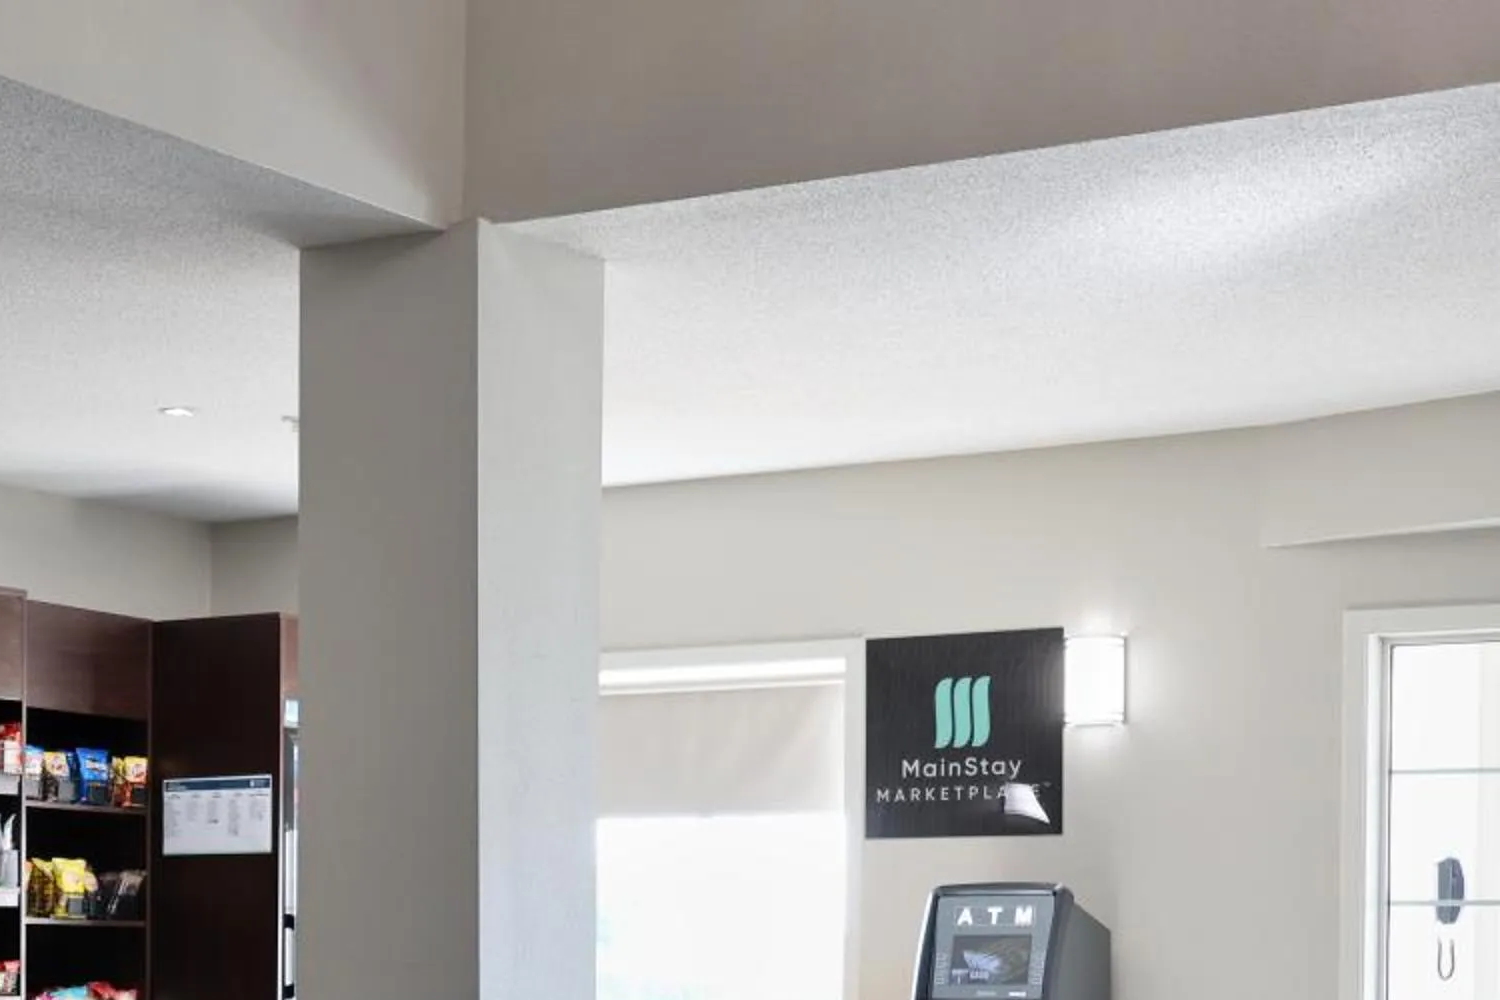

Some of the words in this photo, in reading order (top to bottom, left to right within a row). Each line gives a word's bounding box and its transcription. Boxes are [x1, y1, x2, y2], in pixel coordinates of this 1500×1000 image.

[901, 757, 1022, 779] MainStay
[876, 783, 1041, 803] MARKETPLAE
[956, 905, 1034, 927] ATM
